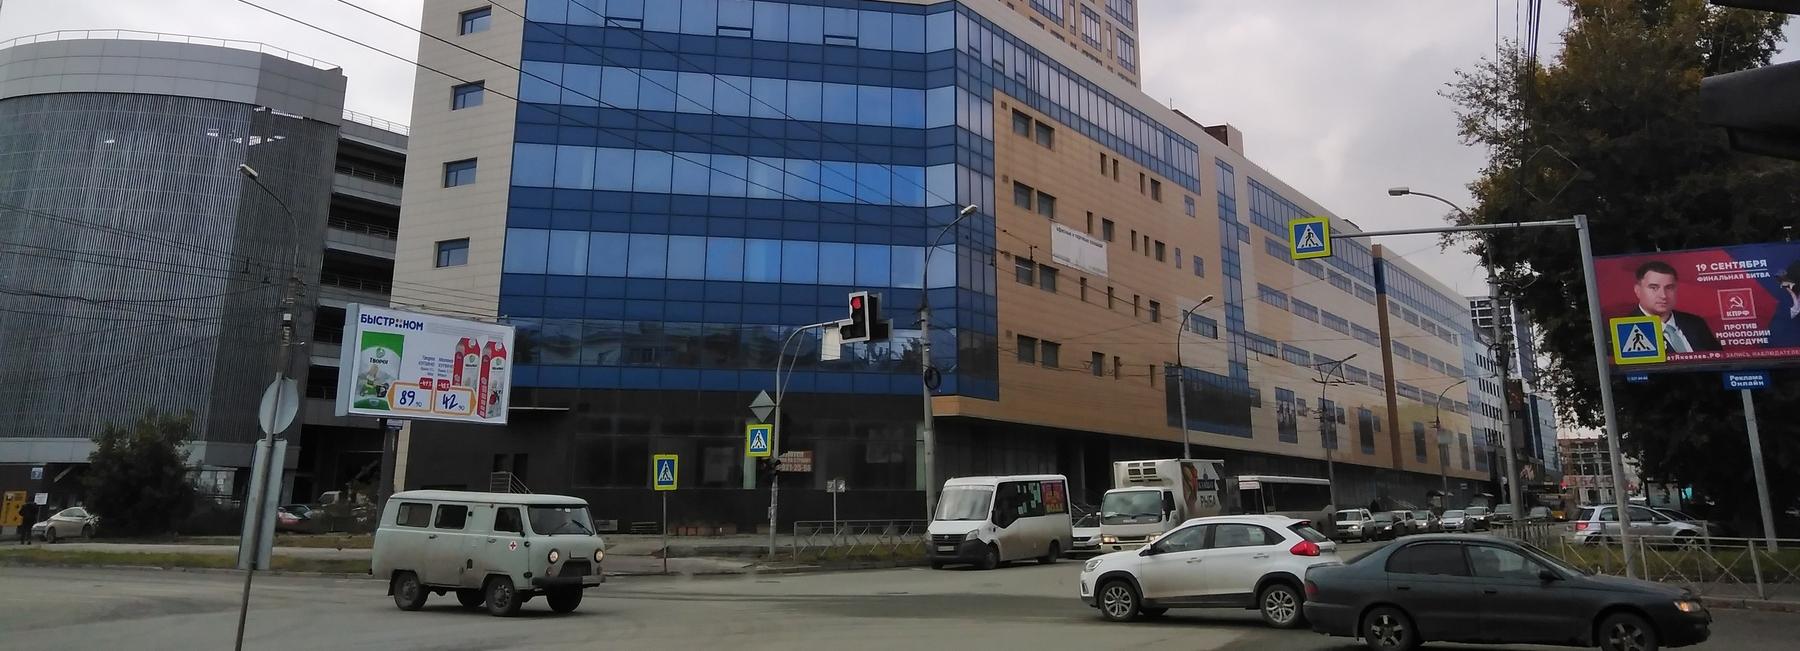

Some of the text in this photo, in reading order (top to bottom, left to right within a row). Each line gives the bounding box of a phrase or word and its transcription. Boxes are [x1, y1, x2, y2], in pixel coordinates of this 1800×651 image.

[1695, 259, 1768, 272] 19 СЕНТЯБРЯ
[1697, 271, 1771, 282] ФИНАЛЬНАЯ БИТВА
[1723, 322, 1758, 331] ПРОТИВ
[1715, 329, 1771, 339] МОНОПОЛИИ
[1728, 337, 1769, 346] ГОСДУМЕ
[1730, 380, 1764, 388] Онлайн
[399, 390, 416, 406] 89
[442, 393, 459, 410] 42
